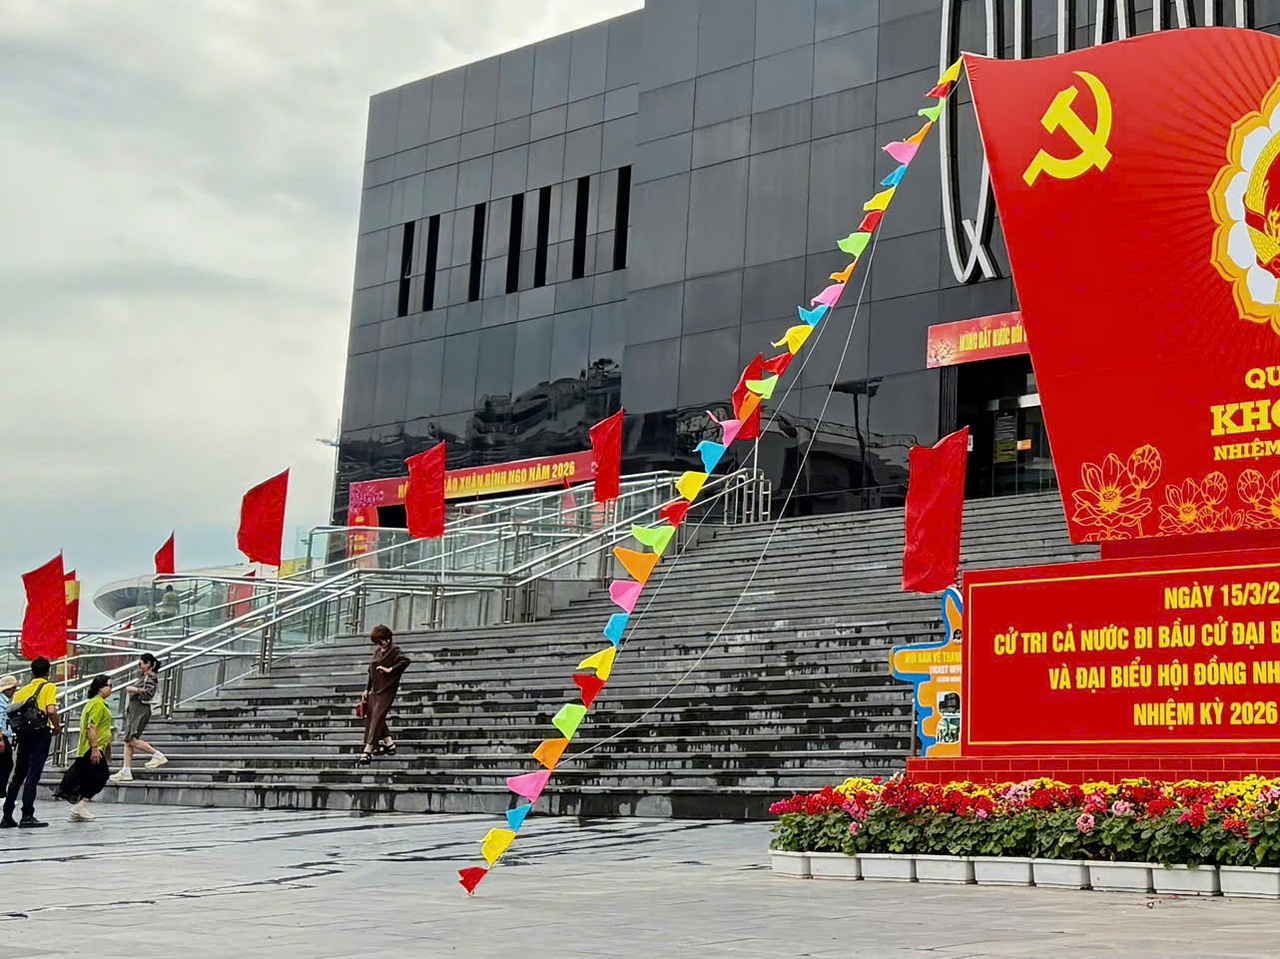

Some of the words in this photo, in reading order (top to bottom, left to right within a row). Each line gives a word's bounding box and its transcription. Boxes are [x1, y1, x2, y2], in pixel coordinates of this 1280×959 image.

[485, 470, 507, 487] BÍNH
[528, 463, 551, 482] NĂM
[552, 461, 575, 478] 2026
[1165, 582, 1214, 609] NGÀY
[994, 627, 1018, 655] CỬ
[1021, 632, 1047, 653] TRI
[1053, 623, 1076, 652] CẢ
[1081, 624, 1129, 651] NƯỚC
[1134, 627, 1152, 649] ĐI
[1158, 618, 1195, 647] BẦU
[1202, 616, 1228, 646] CỬ
[1232, 622, 1264, 649] ĐẠI
[1049, 663, 1071, 689] VÀ
[1076, 667, 1105, 693] ĐẠI
[1111, 656, 1152, 688] BIỂU
[1158, 659, 1188, 691] HỘI
[1194, 655, 1246, 685] ĐỒNG
[1134, 698, 1194, 730] NHIỆM
[1200, 697, 1224, 725] KỲ
[1230, 701, 1278, 724] 2026
